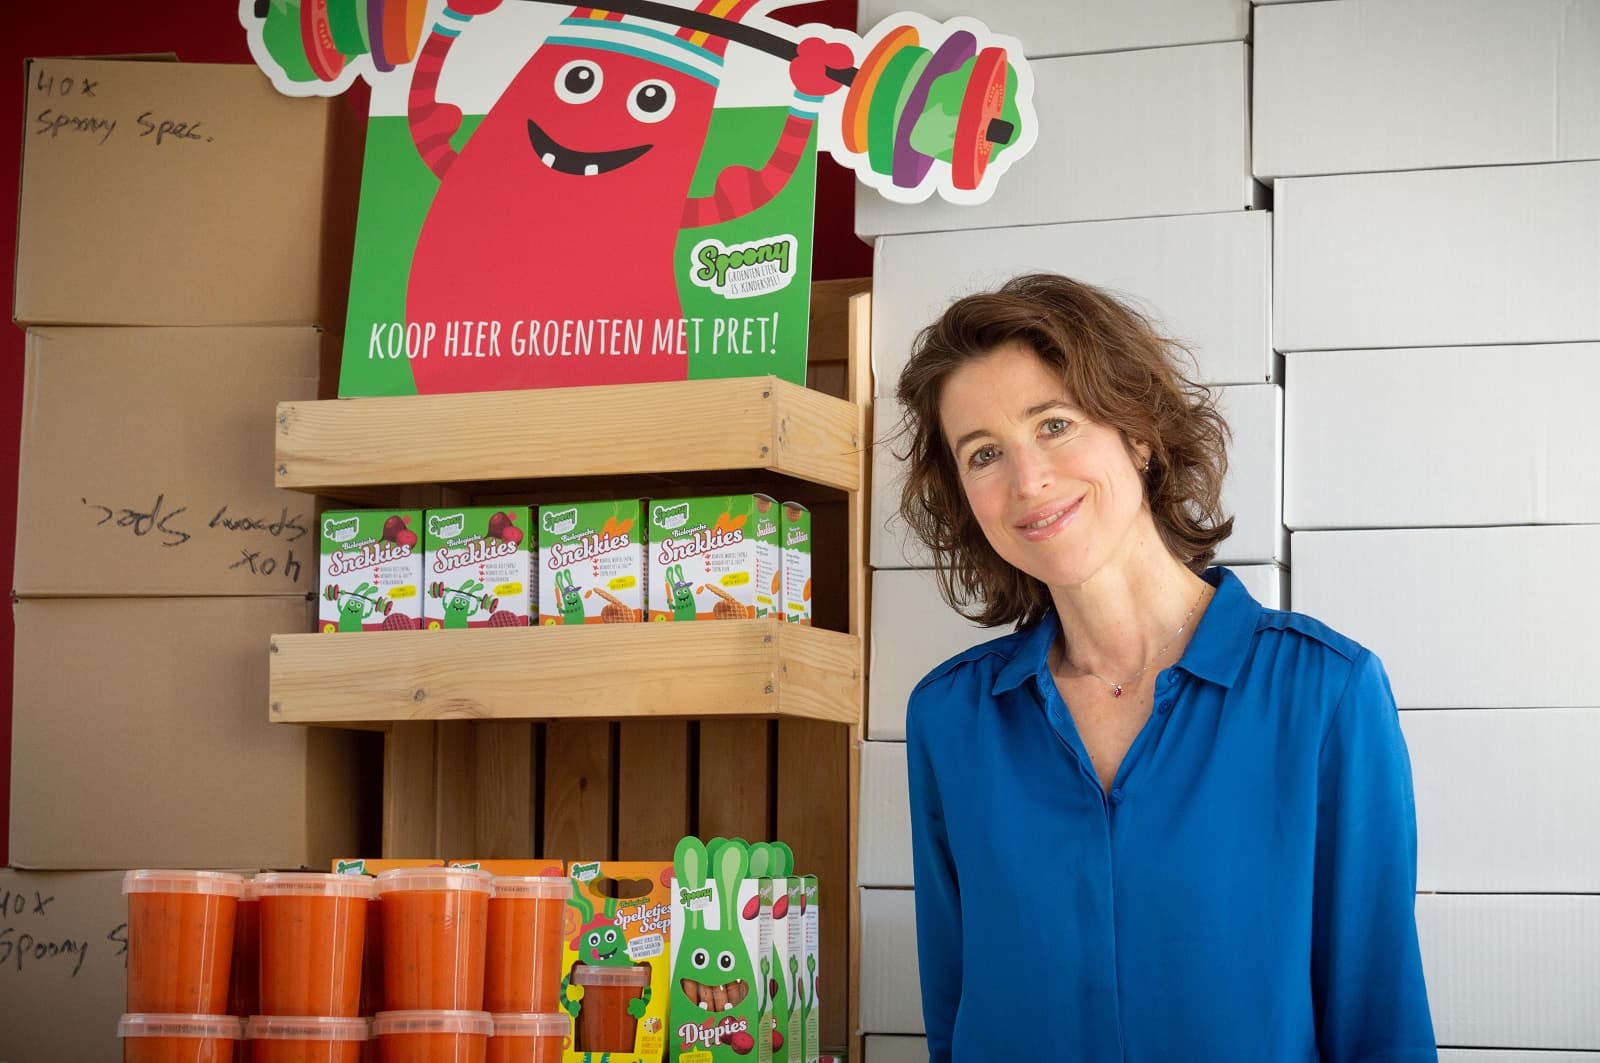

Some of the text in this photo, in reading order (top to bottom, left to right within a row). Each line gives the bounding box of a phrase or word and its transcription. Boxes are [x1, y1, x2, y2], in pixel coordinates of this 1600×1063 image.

[697, 240, 790, 287] Spoony
[368, 312, 779, 359] KOOP HIER GROENTEN MET PRET!
[655, 504, 688, 526] Spoony
[328, 543, 412, 577] Snekkies
[433, 539, 518, 573] Snekkies
[548, 532, 630, 570] Snekkies
[659, 528, 744, 565] Snekkies
[680, 887, 713, 907] Spoony
[640, 917, 671, 934] Soep
[678, 1018, 747, 1048] Dippies
